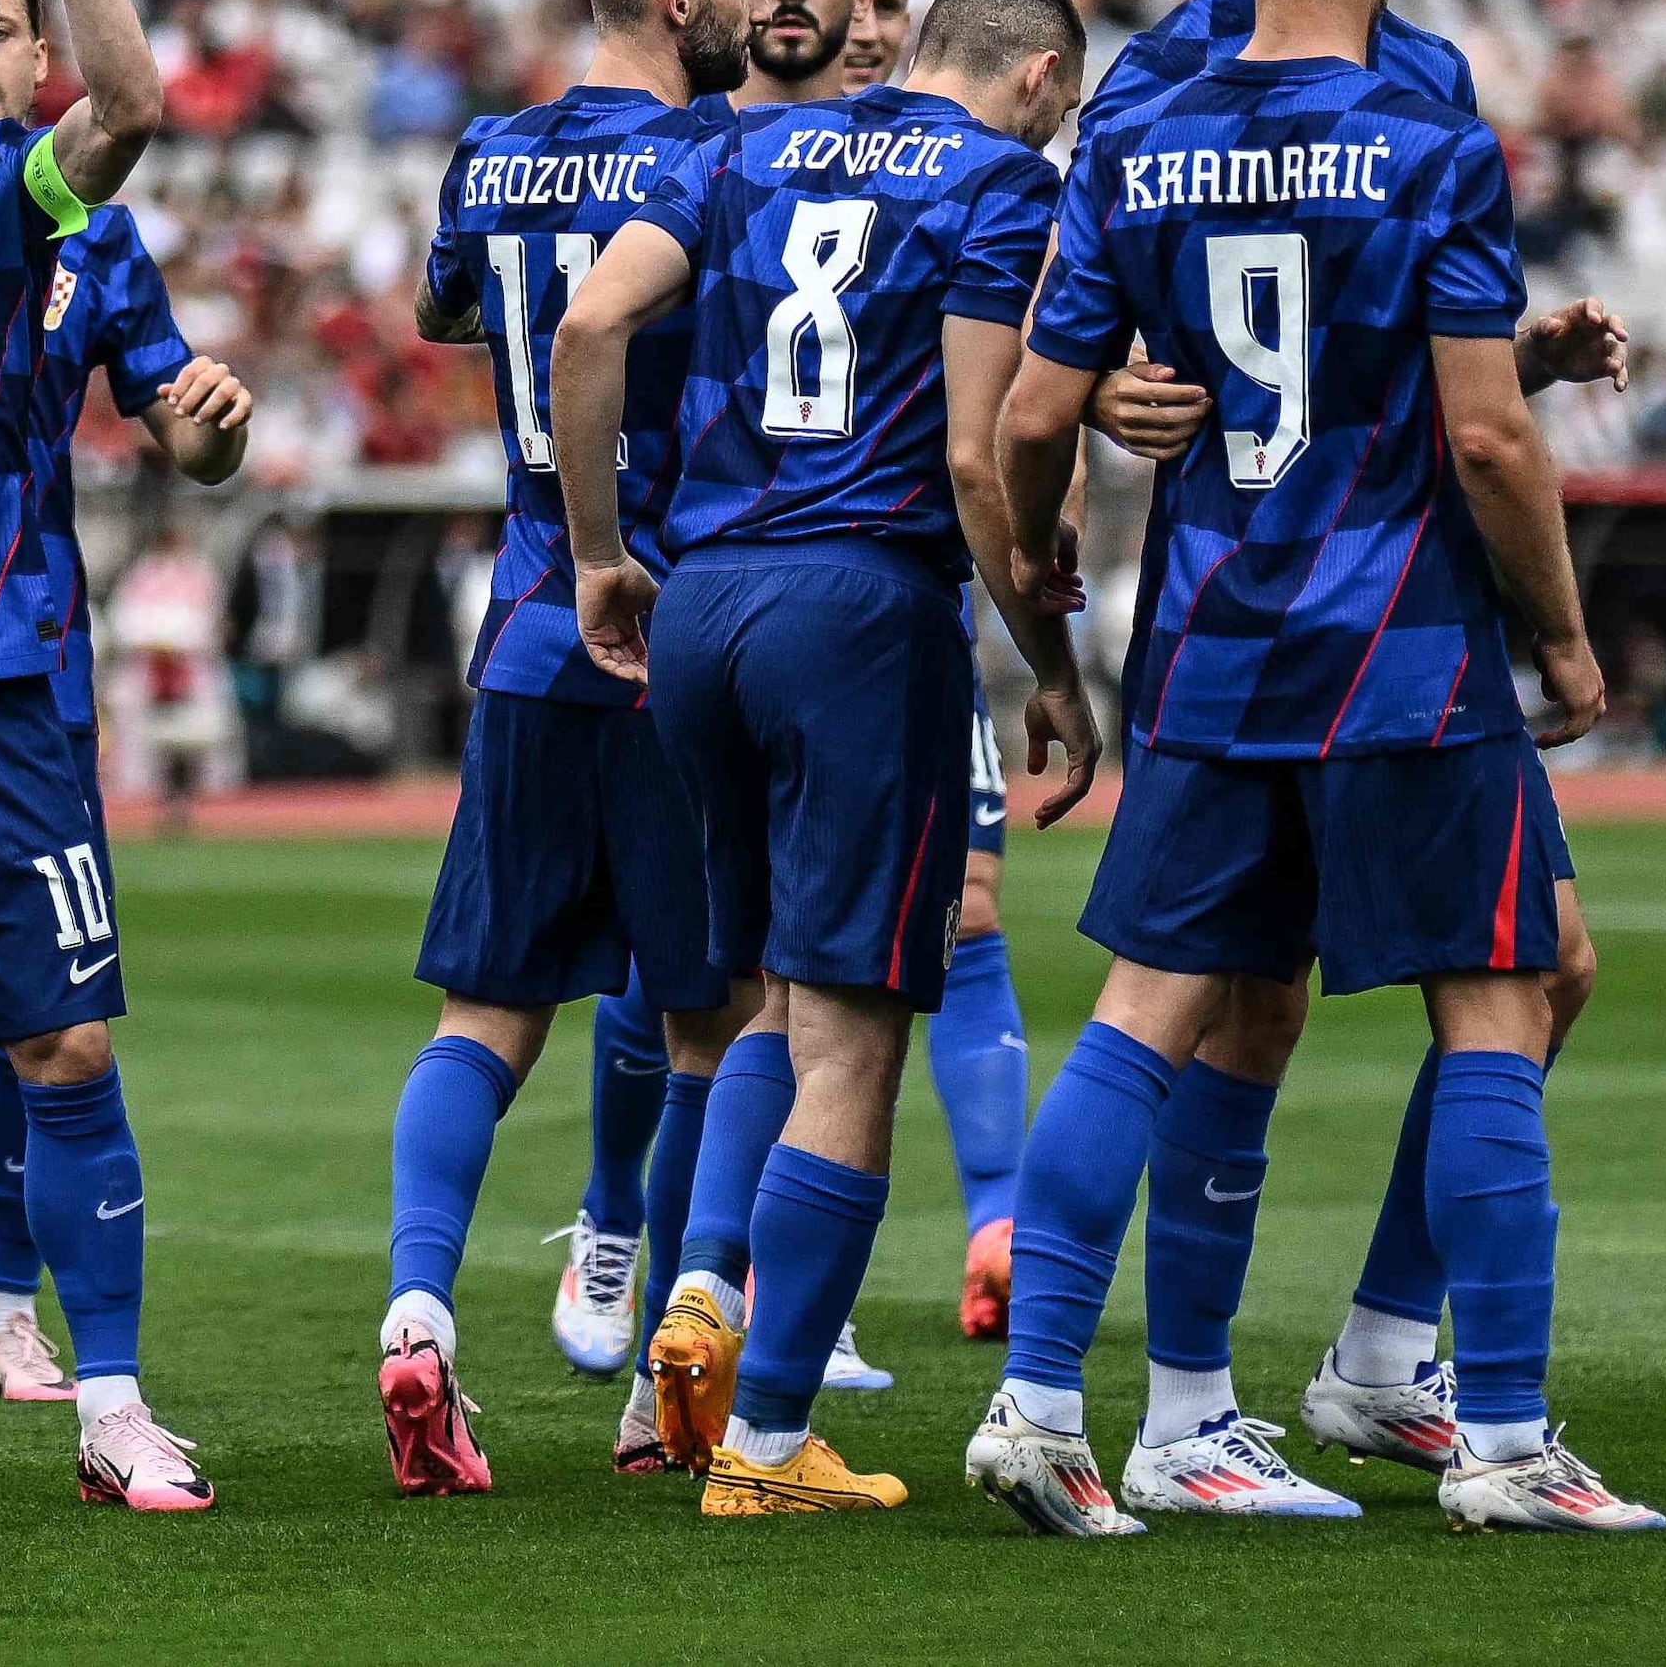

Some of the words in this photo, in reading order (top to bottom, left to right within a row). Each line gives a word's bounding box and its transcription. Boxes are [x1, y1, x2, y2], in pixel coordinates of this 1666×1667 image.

[464, 146, 657, 209] BROZOVIĆ
[771, 127, 964, 178] KOVAČIĆ
[1122, 134, 1391, 213] KRAMARIĆ
[761, 199, 879, 439] 8
[1206, 233, 1311, 489] 9
[33, 843, 112, 949] 10
[1154, 1455, 1211, 1475] F50
